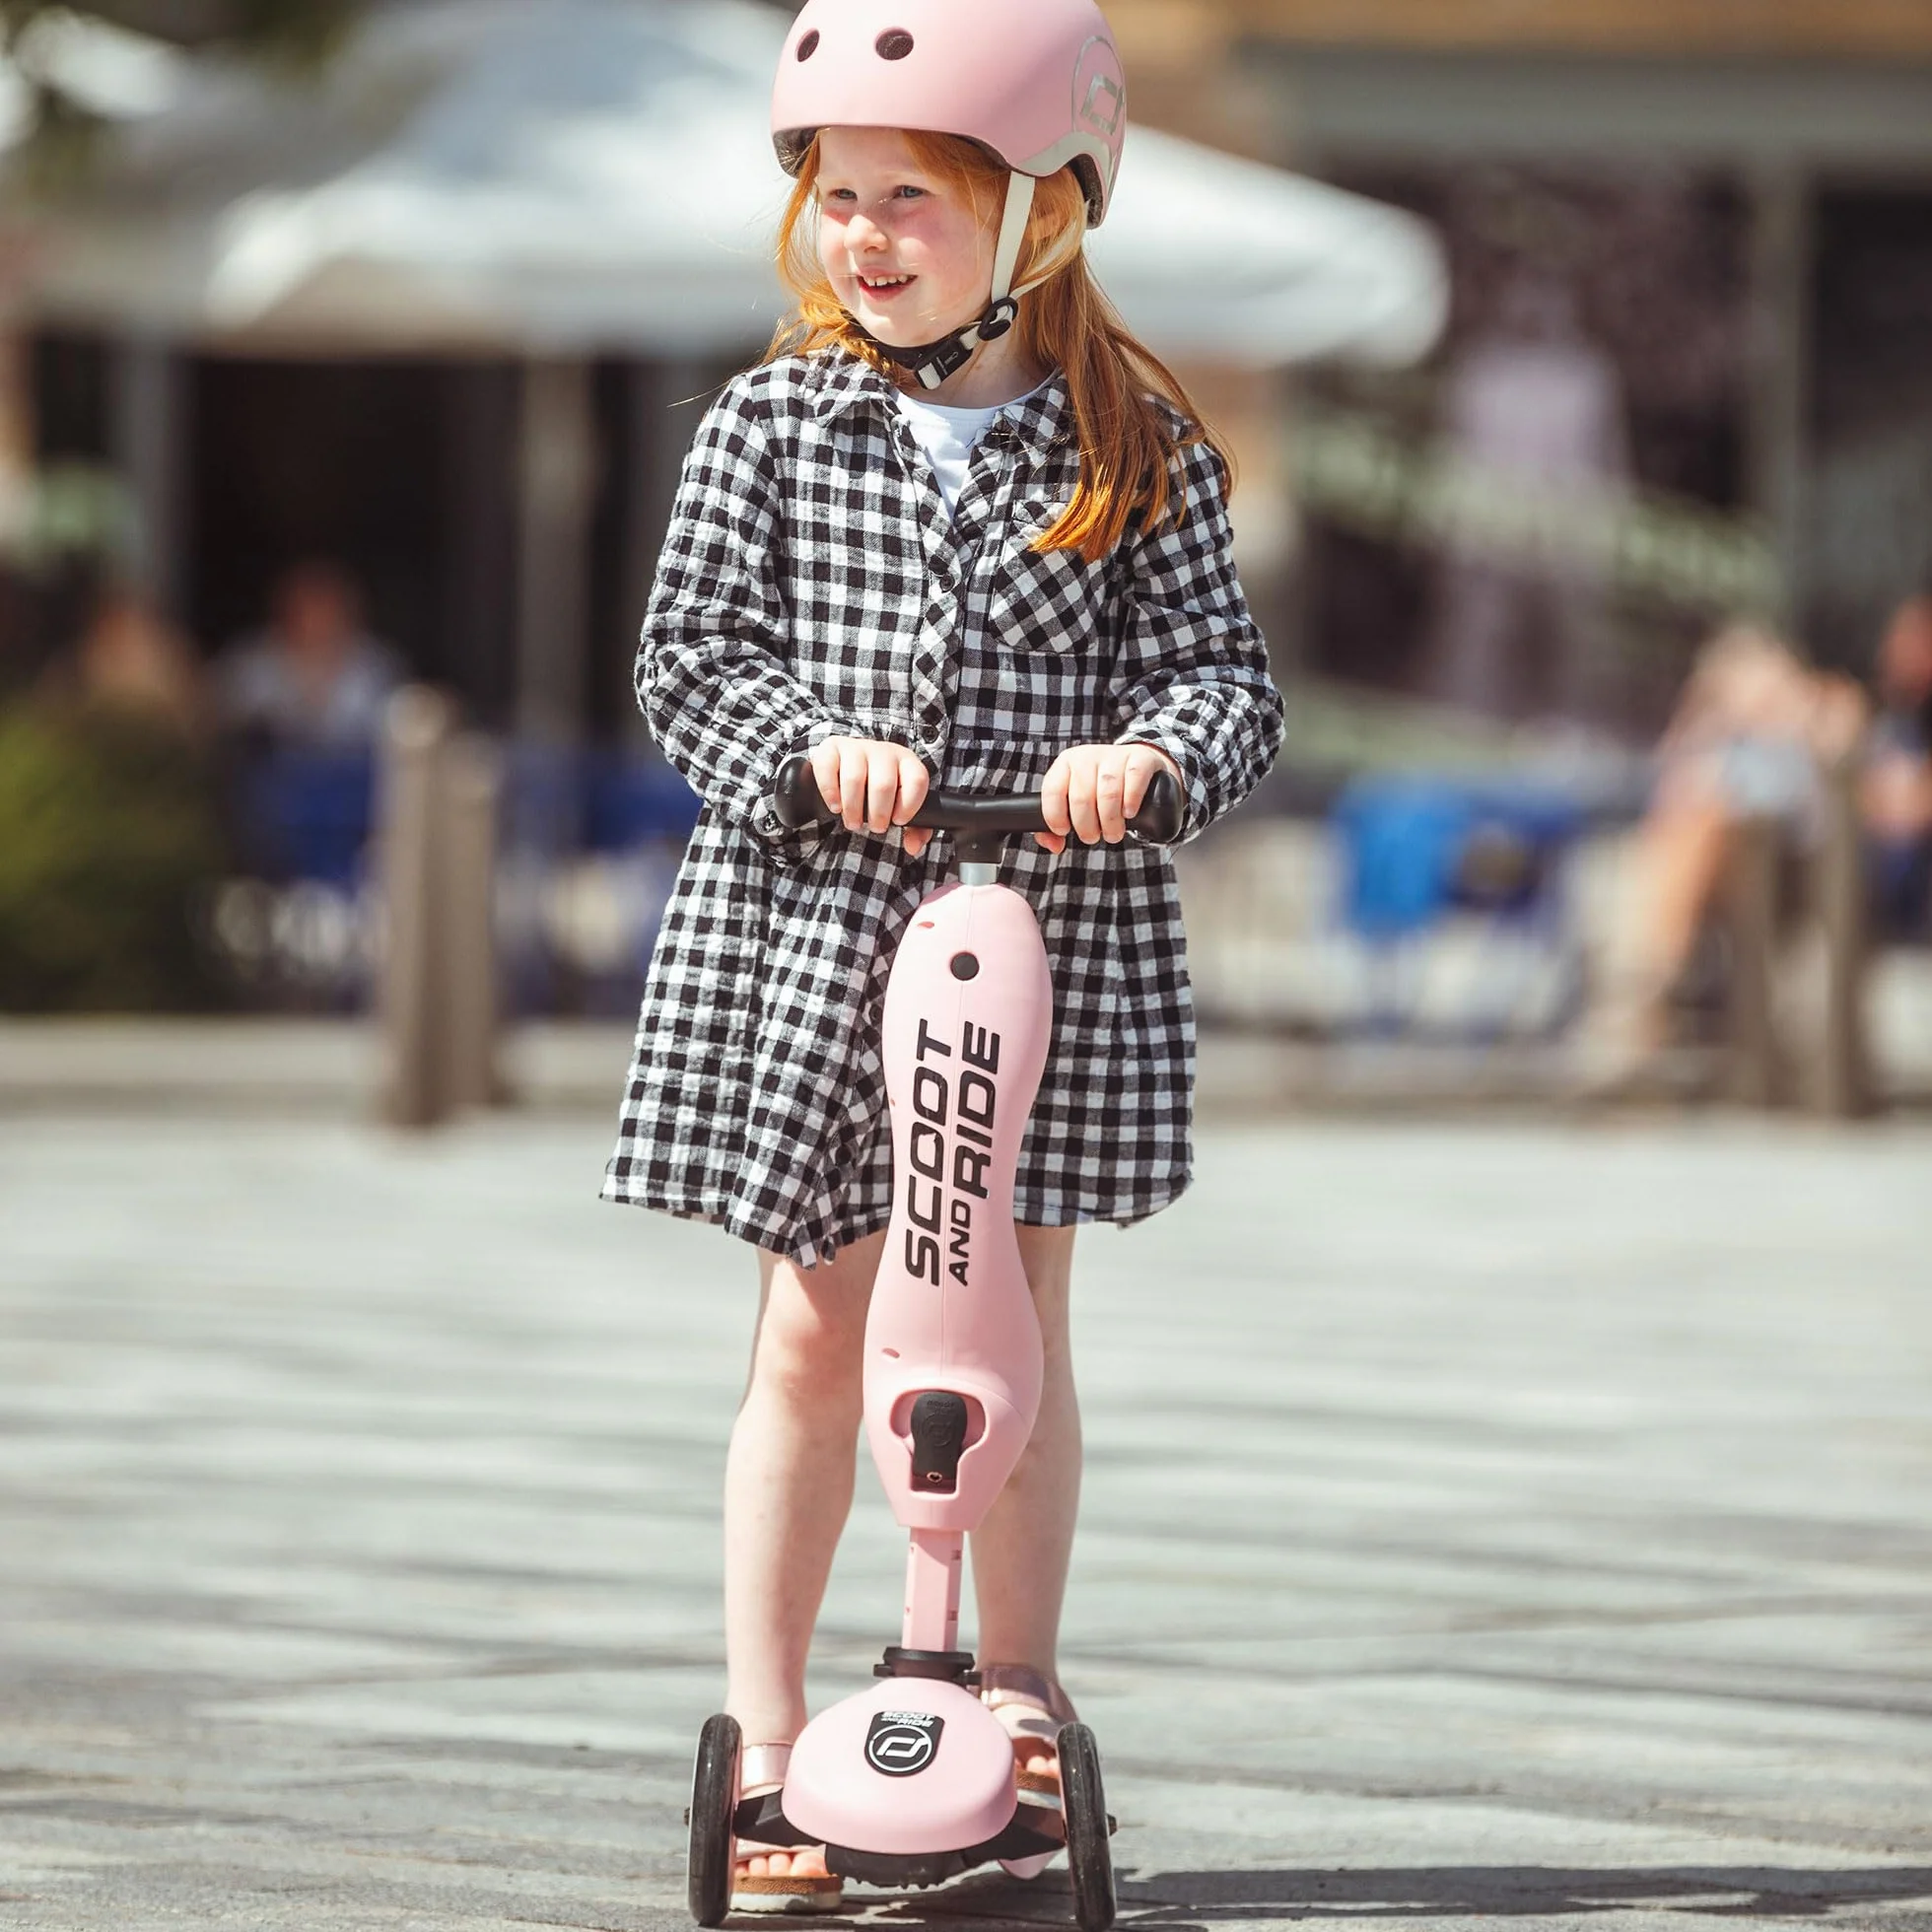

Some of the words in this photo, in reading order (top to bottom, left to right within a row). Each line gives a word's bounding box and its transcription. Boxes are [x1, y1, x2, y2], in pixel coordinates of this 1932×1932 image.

[905, 1018, 951, 1287] SCOOT
[953, 1020, 1000, 1200] RIDE
[948, 1199, 971, 1287] AND
